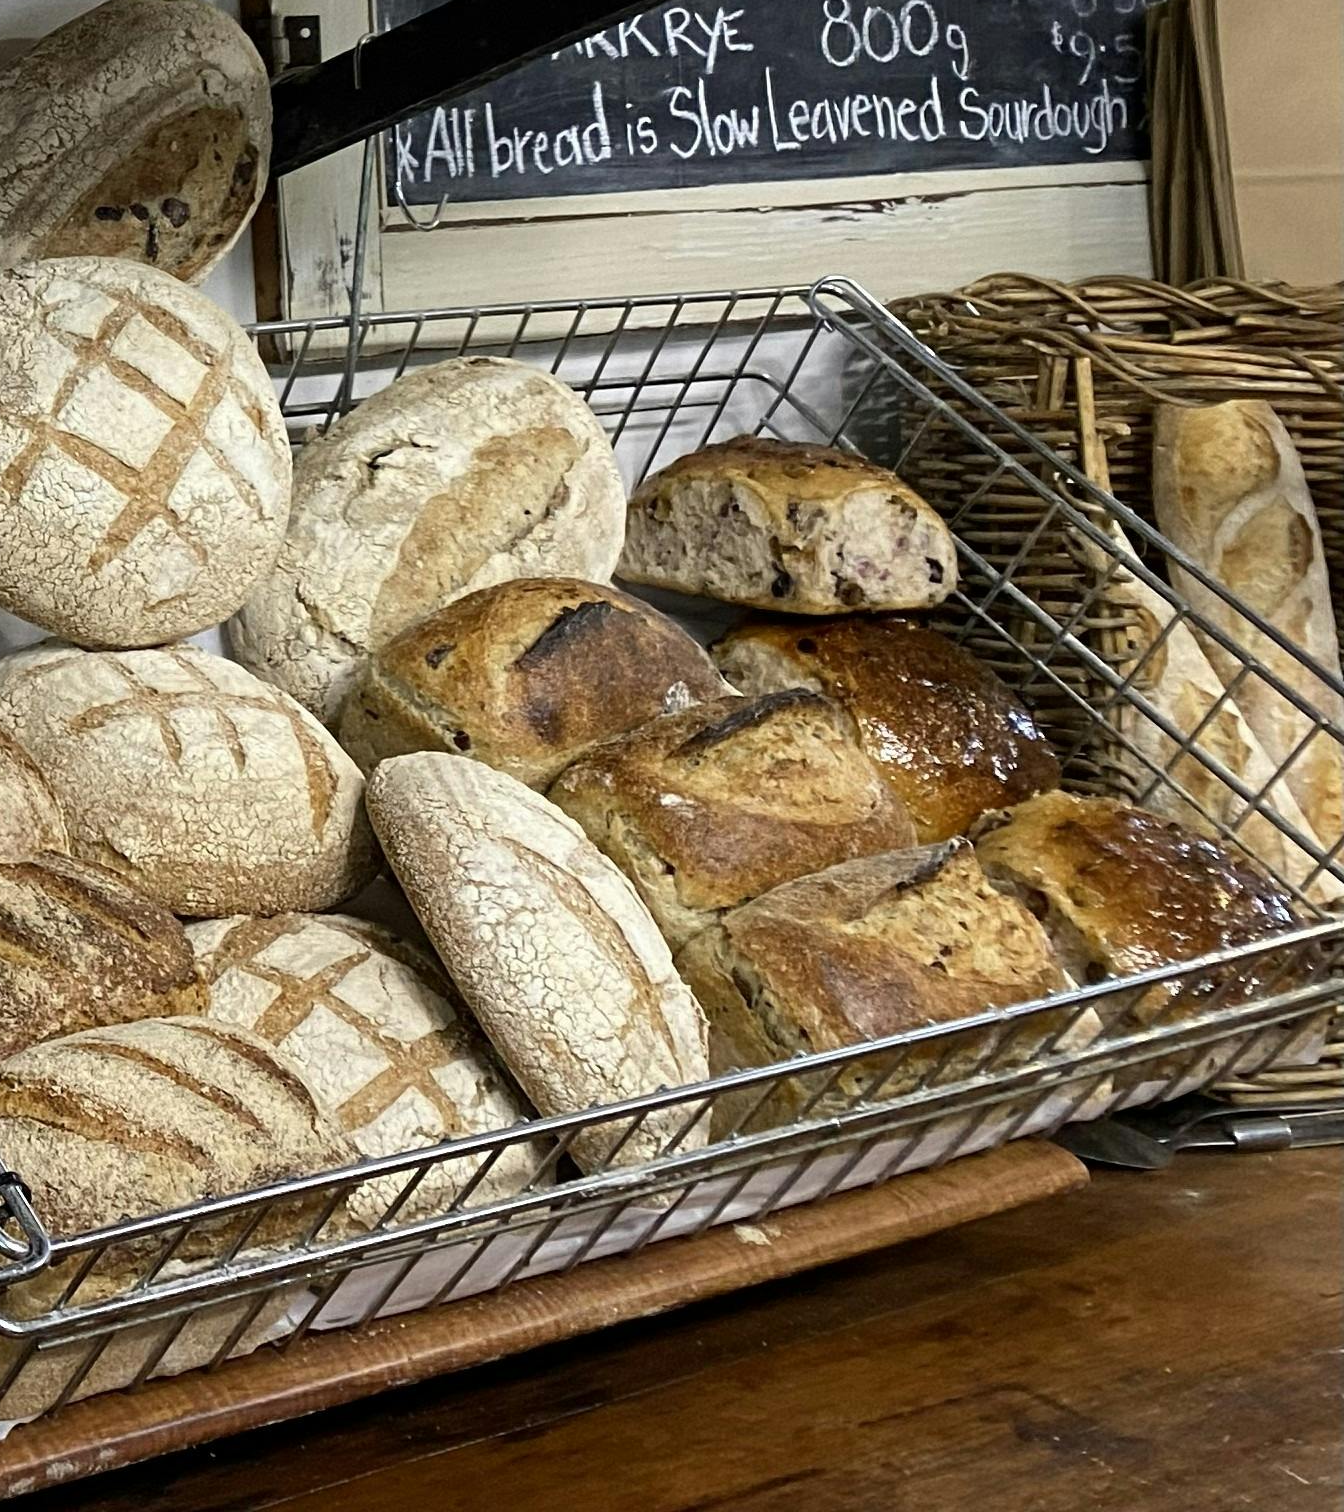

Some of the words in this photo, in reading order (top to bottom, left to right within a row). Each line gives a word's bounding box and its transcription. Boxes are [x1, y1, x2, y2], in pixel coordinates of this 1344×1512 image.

[1050, 20, 1142, 86] $9.5
[484, 81, 612, 179] bread
[625, 103, 658, 156] is
[666, 76, 760, 160] Slow
[764, 66, 946, 152] Leavened
[959, 77, 1128, 154] Sourdough
